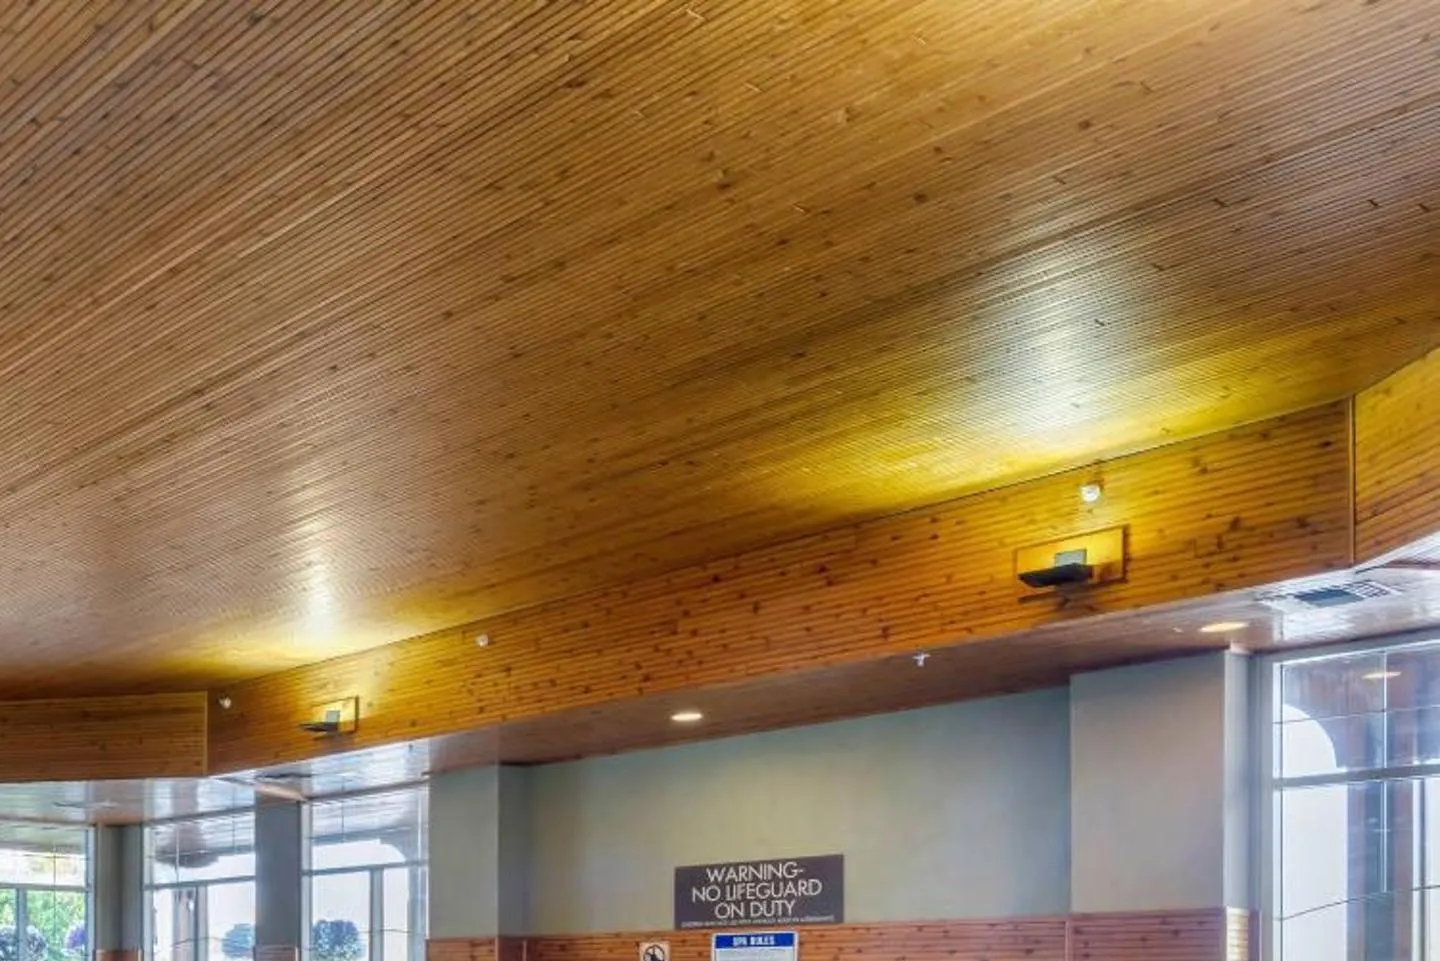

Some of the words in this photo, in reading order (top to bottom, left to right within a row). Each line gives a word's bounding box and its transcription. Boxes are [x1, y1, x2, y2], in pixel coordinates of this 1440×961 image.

[691, 885, 721, 903] NO
[726, 879, 823, 901] LIFEGUARD
[714, 902, 745, 919] ON
[750, 900, 796, 917] DUTY
